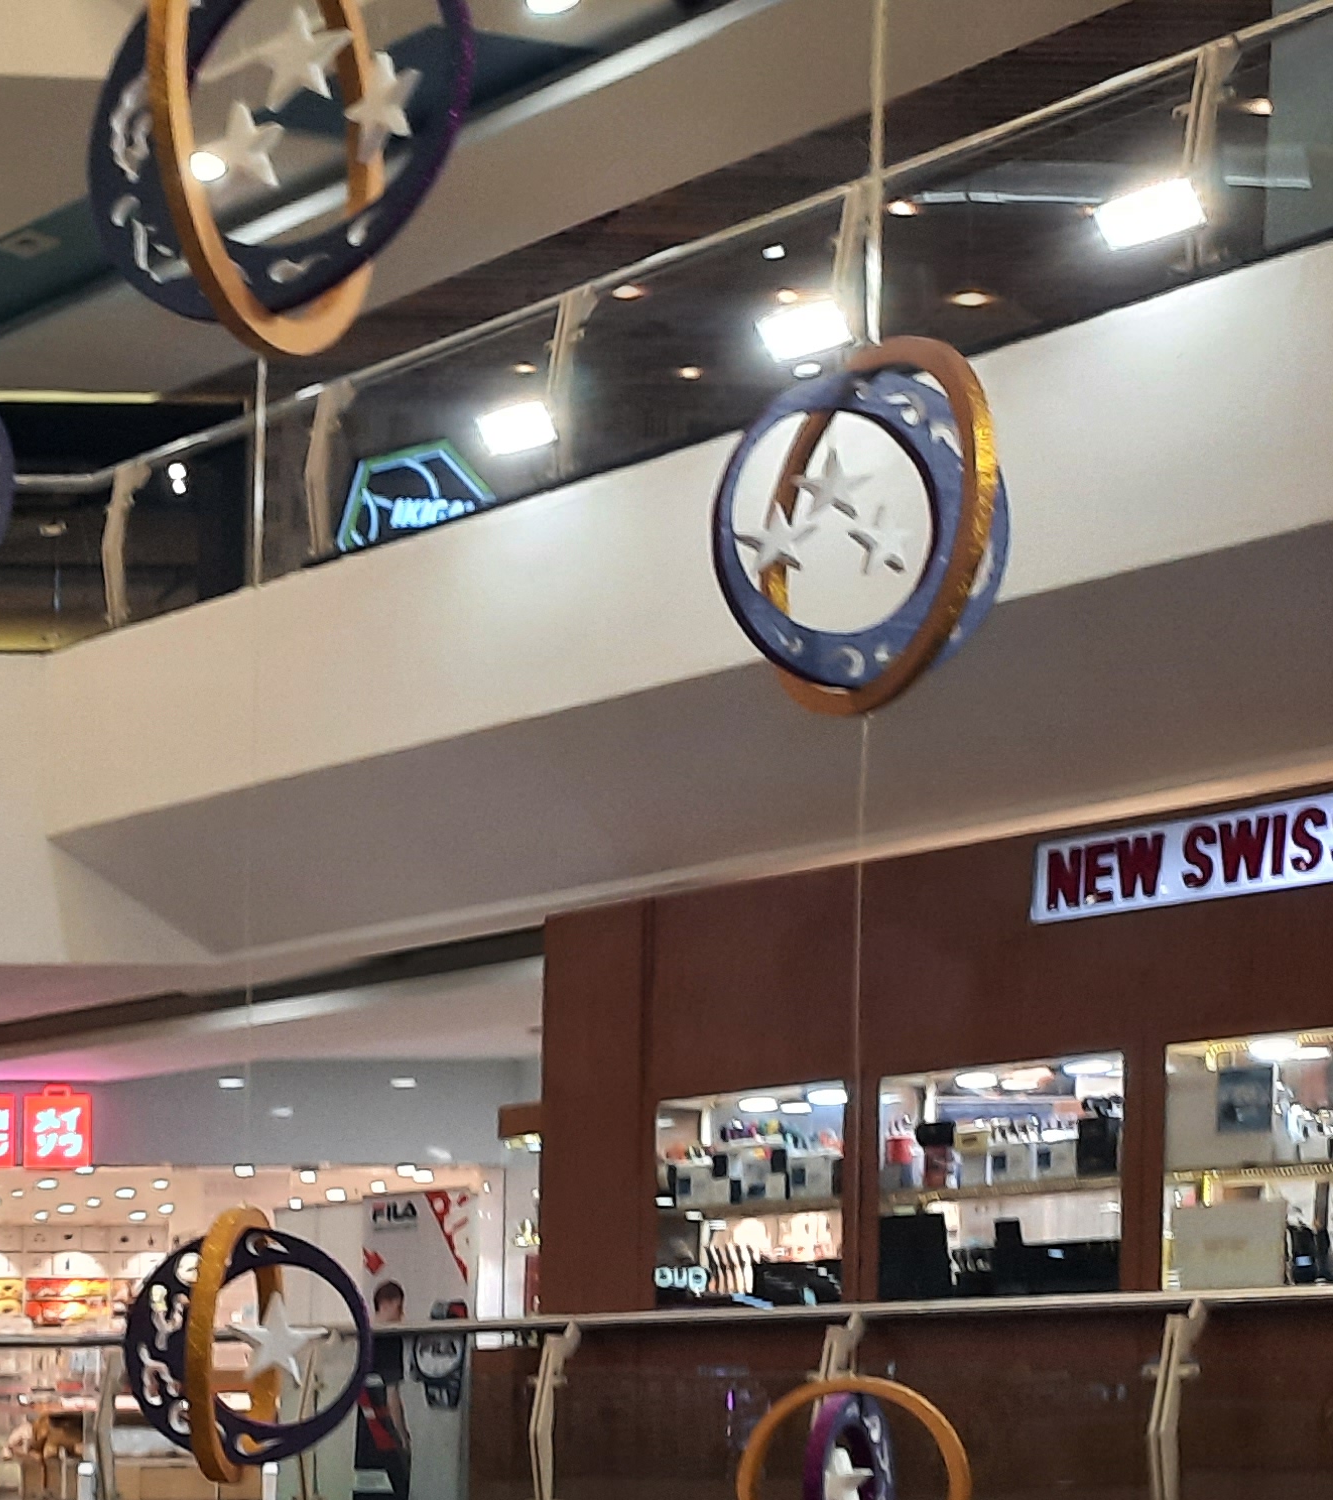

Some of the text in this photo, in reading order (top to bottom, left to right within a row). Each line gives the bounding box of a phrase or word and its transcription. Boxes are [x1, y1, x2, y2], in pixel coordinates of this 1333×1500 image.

[1047, 807, 1333, 911] NEW SWIS
[372, 1201, 418, 1223] FILA
